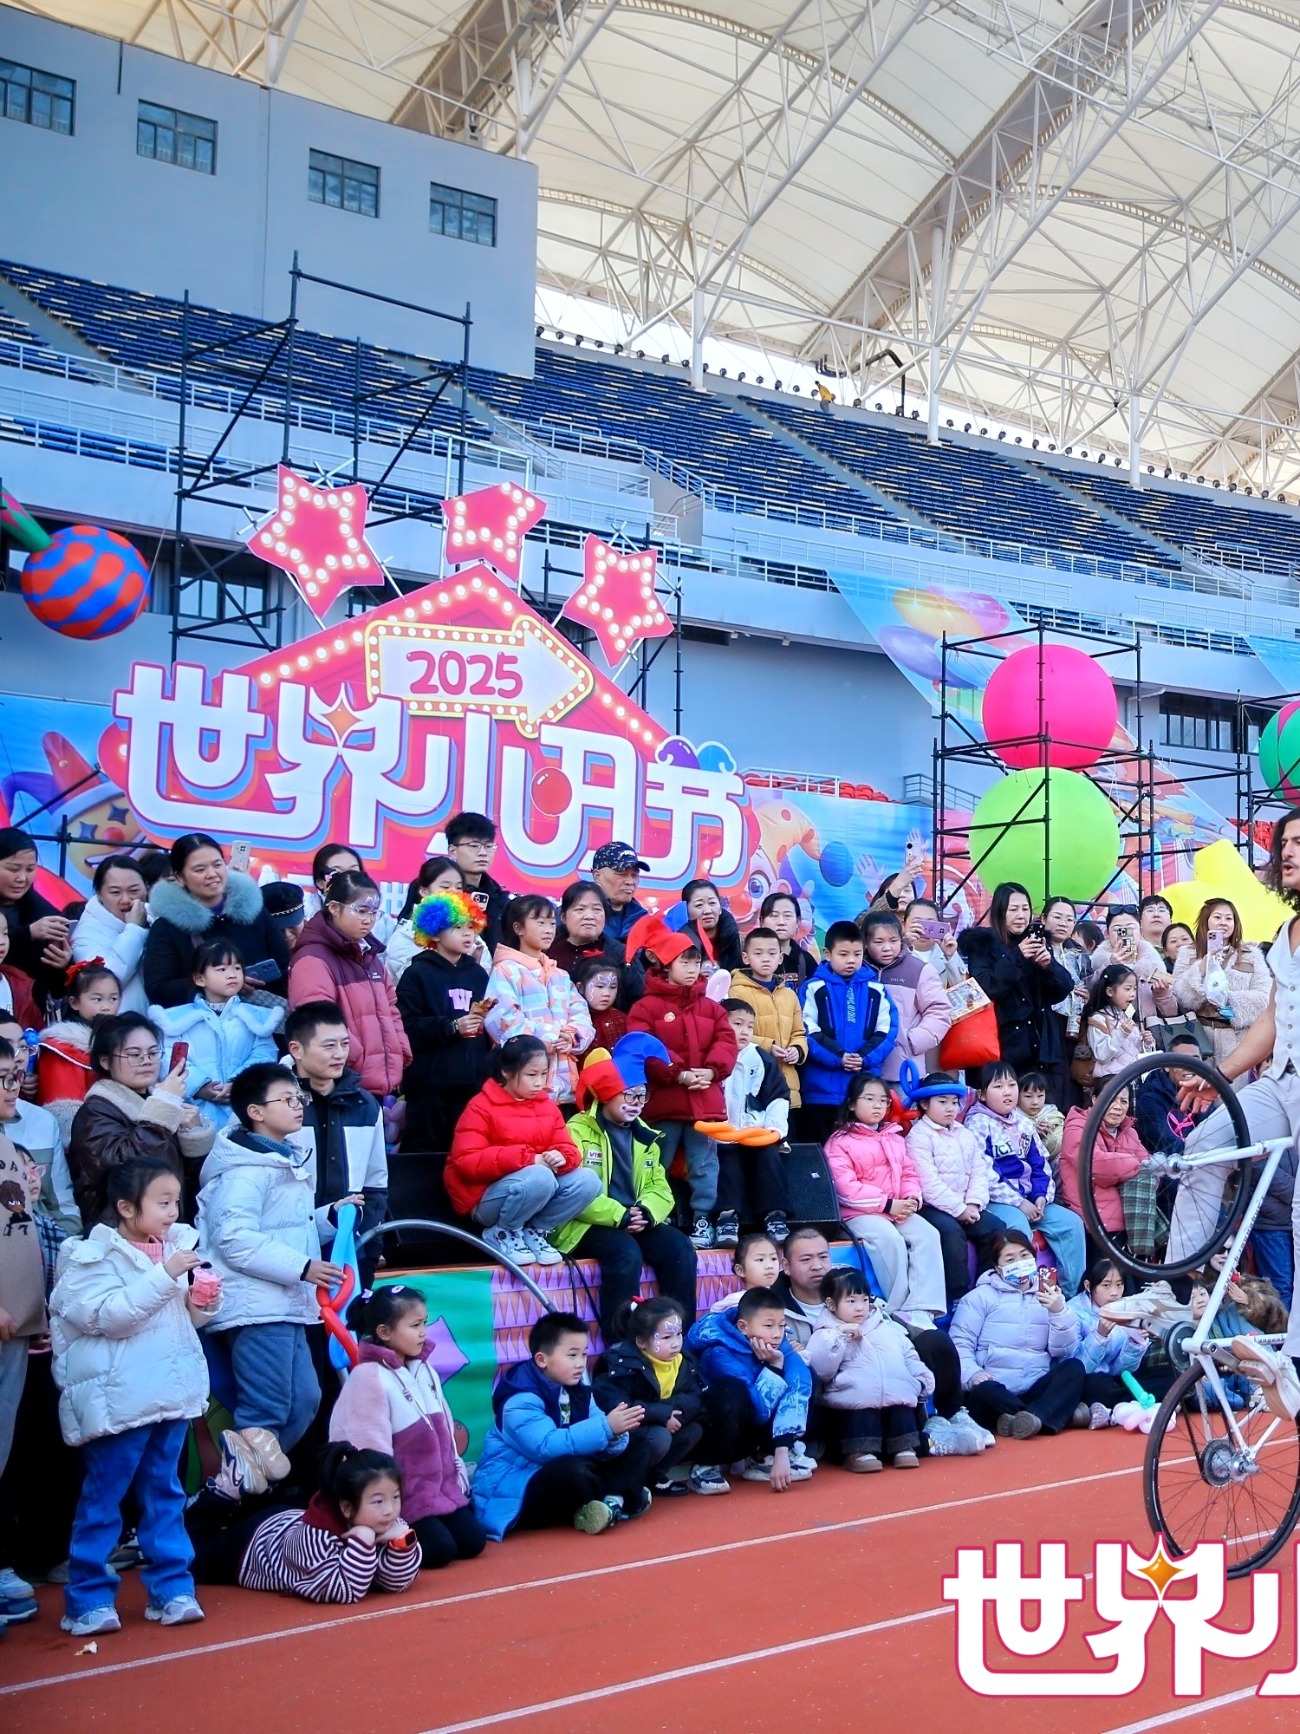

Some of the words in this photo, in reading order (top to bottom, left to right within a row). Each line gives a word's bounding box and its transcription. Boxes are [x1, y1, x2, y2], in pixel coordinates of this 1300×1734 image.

[406, 650, 523, 699] 2025
[114, 663, 744, 880] 世界小丑节
